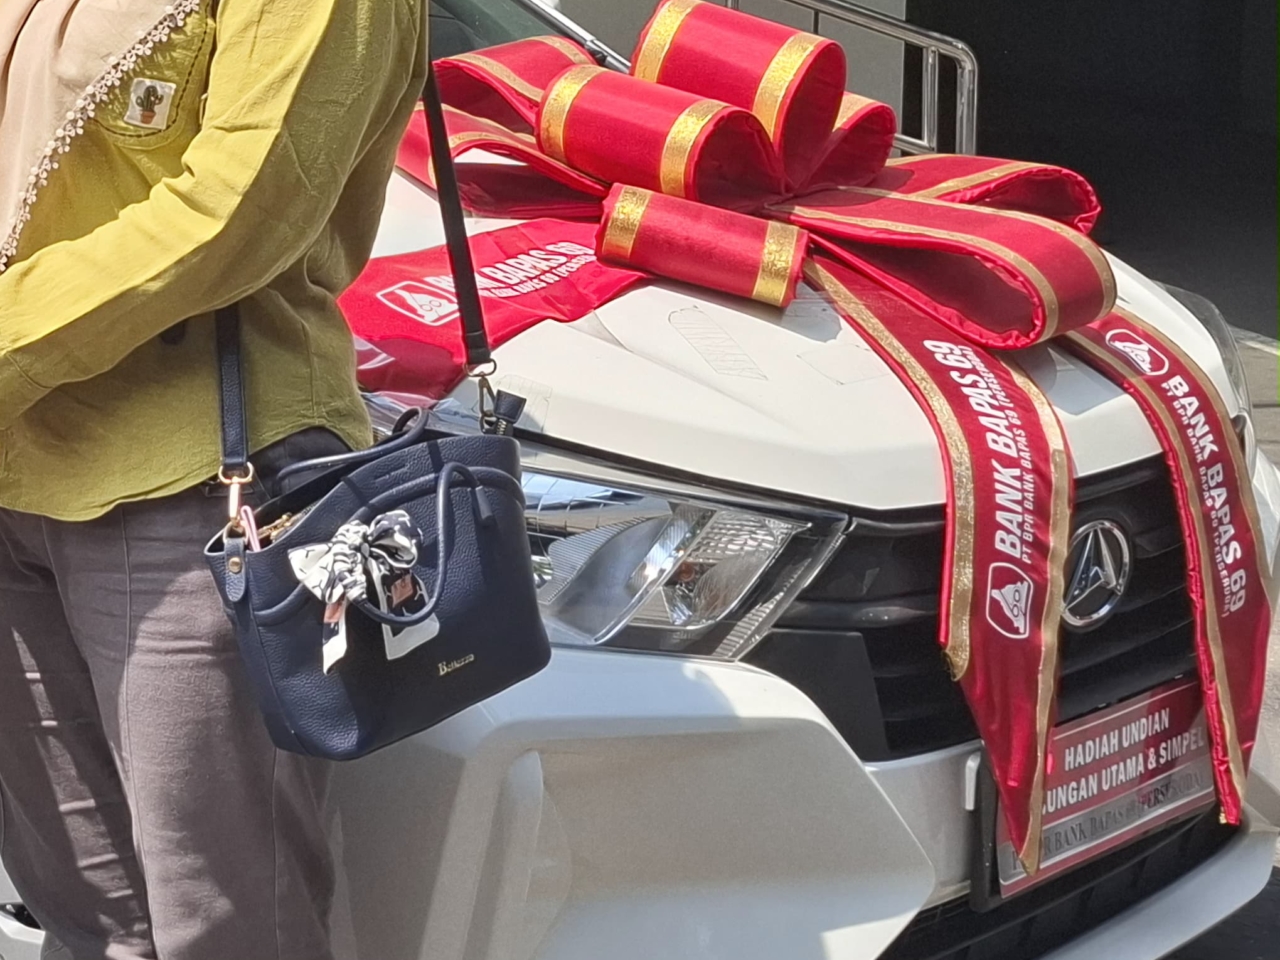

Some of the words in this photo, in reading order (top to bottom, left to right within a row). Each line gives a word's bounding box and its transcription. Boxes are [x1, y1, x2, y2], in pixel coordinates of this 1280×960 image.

[480, 249, 568, 285] BAPAS
[923, 340, 974, 369] 69
[950, 370, 1018, 458] BAPAS
[1004, 409, 1022, 425] 69
[1012, 427, 1033, 470] BAPAS
[1186, 428, 1204, 463] BANK
[1199, 466, 1213, 507] BAPAS
[991, 458, 1023, 558] BANK
[1023, 471, 1035, 510] BANK
[1167, 375, 1219, 460] BANK
[1207, 462, 1242, 564] BAPAS
[1230, 569, 1246, 613] 69
[1022, 514, 1035, 542] BPR
[1021, 544, 1033, 564] PT
[1064, 729, 1119, 771] HADIAH
[1122, 707, 1170, 748] UNDIAN
[1042, 772, 1098, 815] UNGAN
[1102, 753, 1145, 791] UTAMA
[1147, 747, 1157, 770] &
[1054, 823, 1087, 852] BANK
